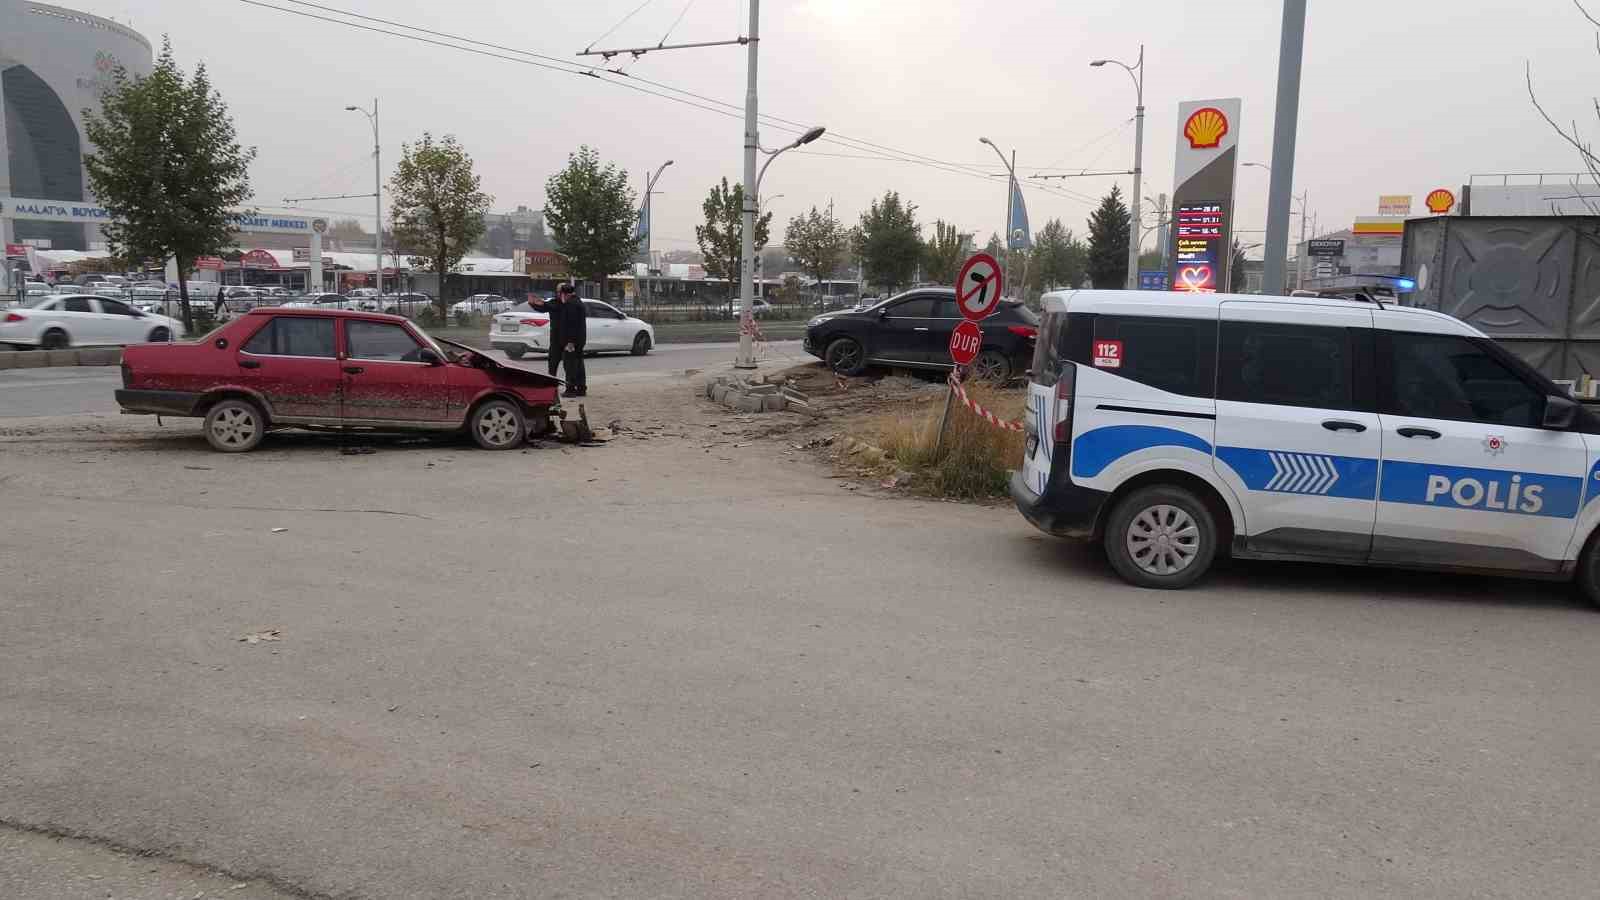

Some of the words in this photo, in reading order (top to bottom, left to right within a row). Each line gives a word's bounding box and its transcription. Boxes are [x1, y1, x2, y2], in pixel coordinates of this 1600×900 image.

[16, 204, 68, 216] MALATYA
[952, 332, 979, 354] DUR
[1097, 343, 1118, 358] 112
[1425, 474, 1545, 513] POLİS
